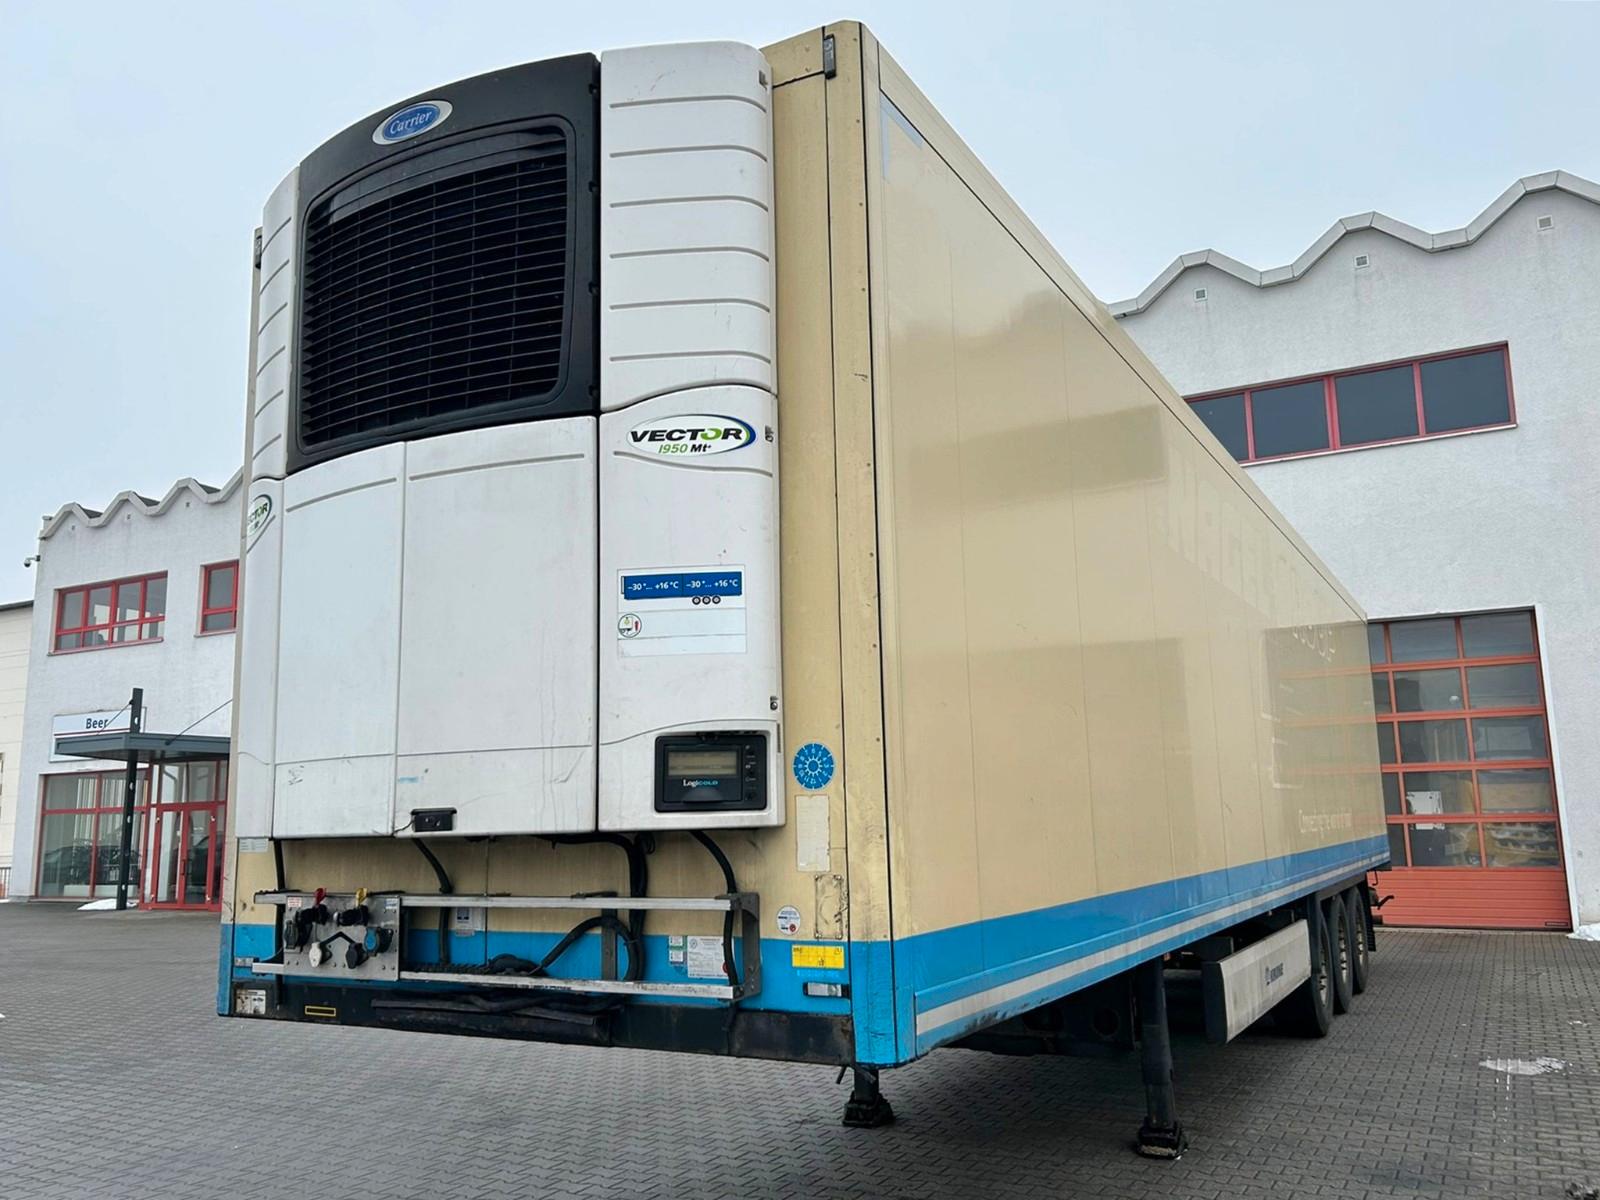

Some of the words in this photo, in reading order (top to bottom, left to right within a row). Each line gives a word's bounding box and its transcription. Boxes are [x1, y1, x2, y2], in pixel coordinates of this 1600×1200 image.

[389, 111, 432, 134] Carrier
[630, 428, 742, 442] VECTOR
[658, 443, 688, 454] 1950
[85, 717, 109, 730] Beer
